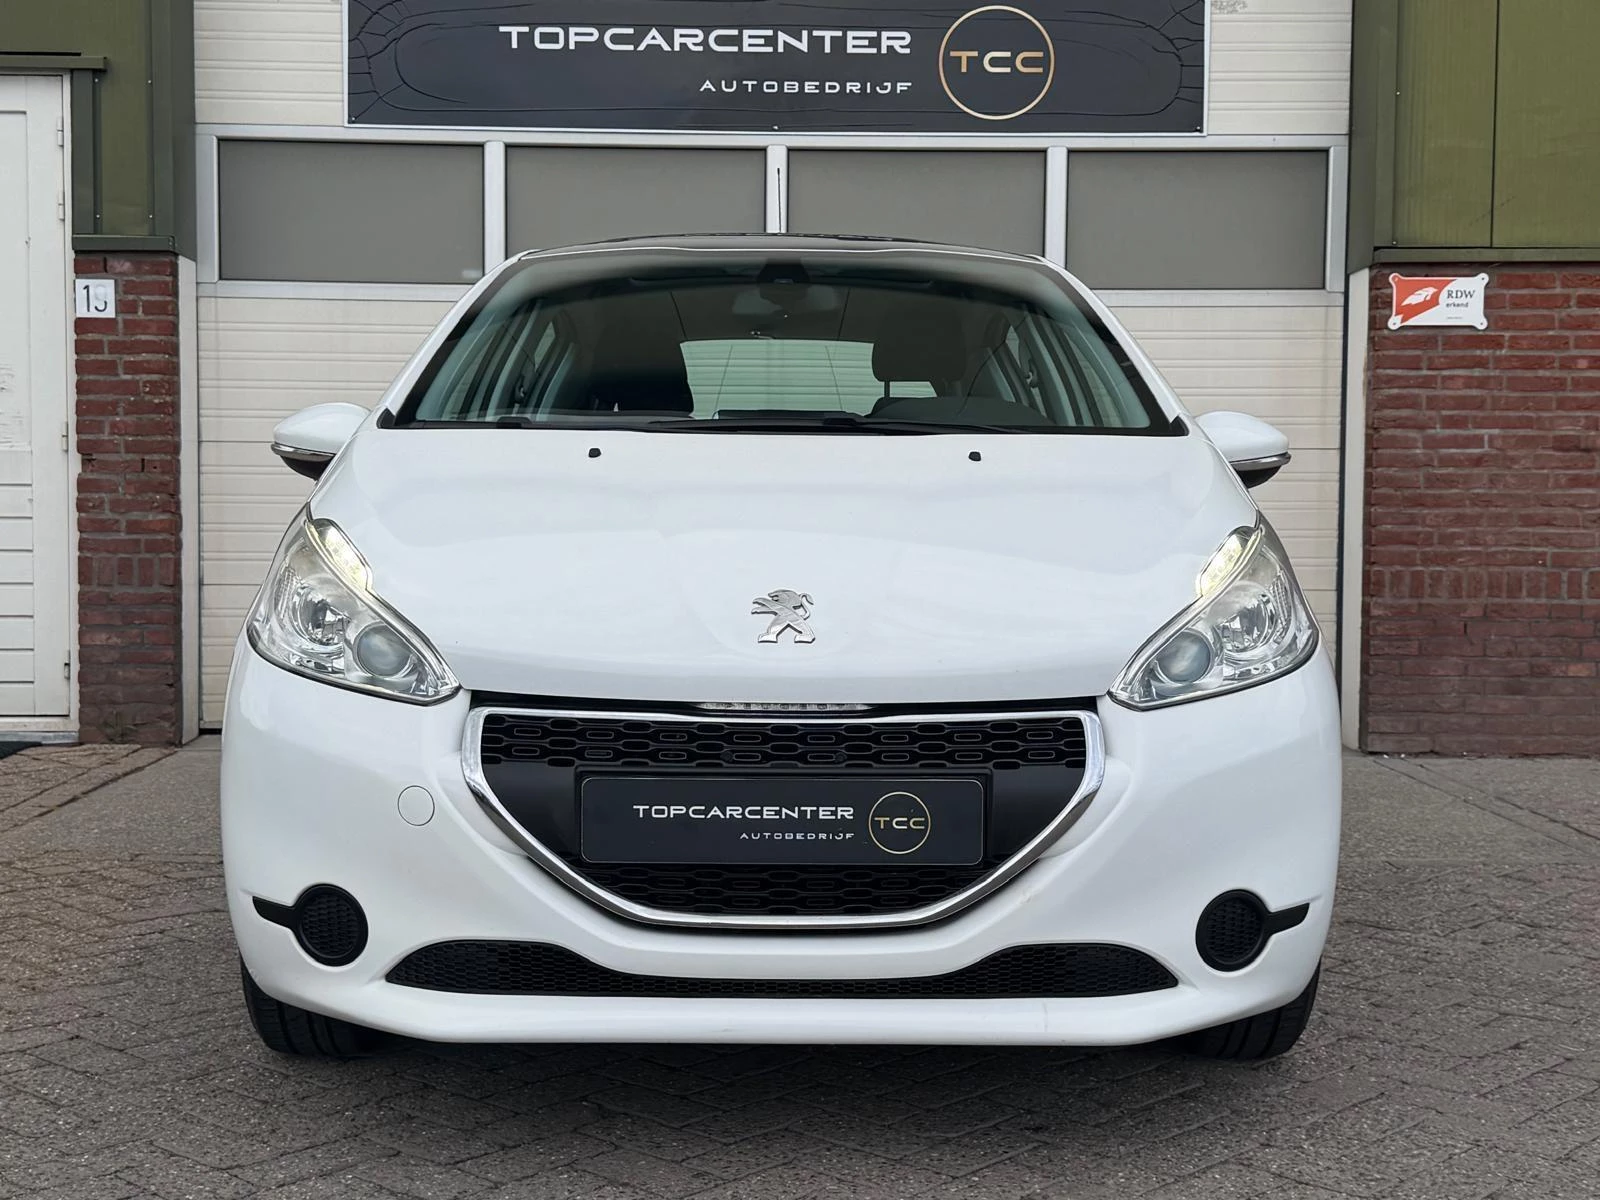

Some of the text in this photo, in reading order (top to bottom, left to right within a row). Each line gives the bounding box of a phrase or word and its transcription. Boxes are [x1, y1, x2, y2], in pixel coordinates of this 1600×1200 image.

[498, 25, 912, 54] TOPCARCENTER
[949, 50, 1044, 73] TCC
[699, 79, 913, 95] AUTOBEDRIJF
[1446, 289, 1476, 299] RDW
[632, 805, 855, 820] TOPCARCENTER
[874, 816, 926, 830] TCC
[739, 832, 855, 840] AUTOBEDRIJF
